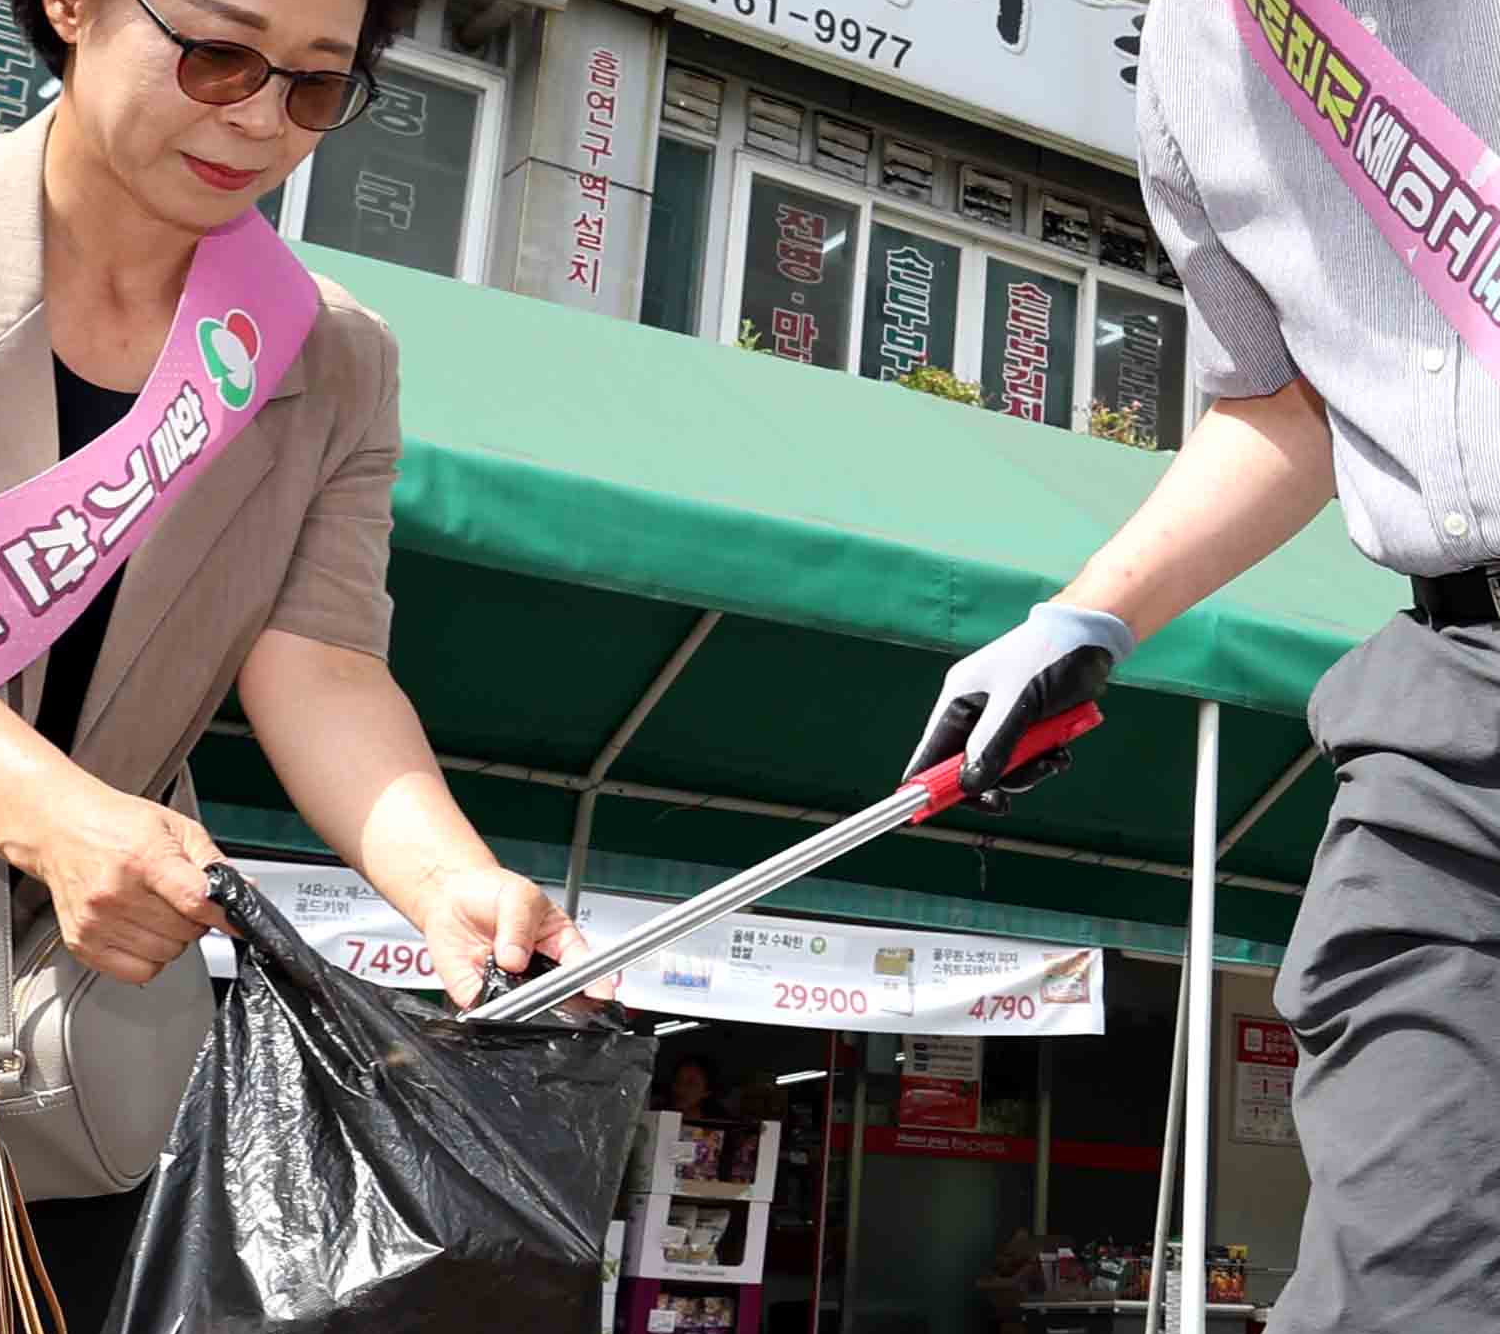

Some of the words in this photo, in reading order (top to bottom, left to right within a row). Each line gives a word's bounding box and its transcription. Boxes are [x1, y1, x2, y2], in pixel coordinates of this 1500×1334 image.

[567, 50, 621, 294] 흡연구역설치
[0, 380, 212, 618] 활기찬
[295, 898, 351, 915] 골드키위
[346, 941, 437, 976] 7,490
[772, 981, 868, 1015] 29,900
[967, 994, 1036, 1024] 4,790
